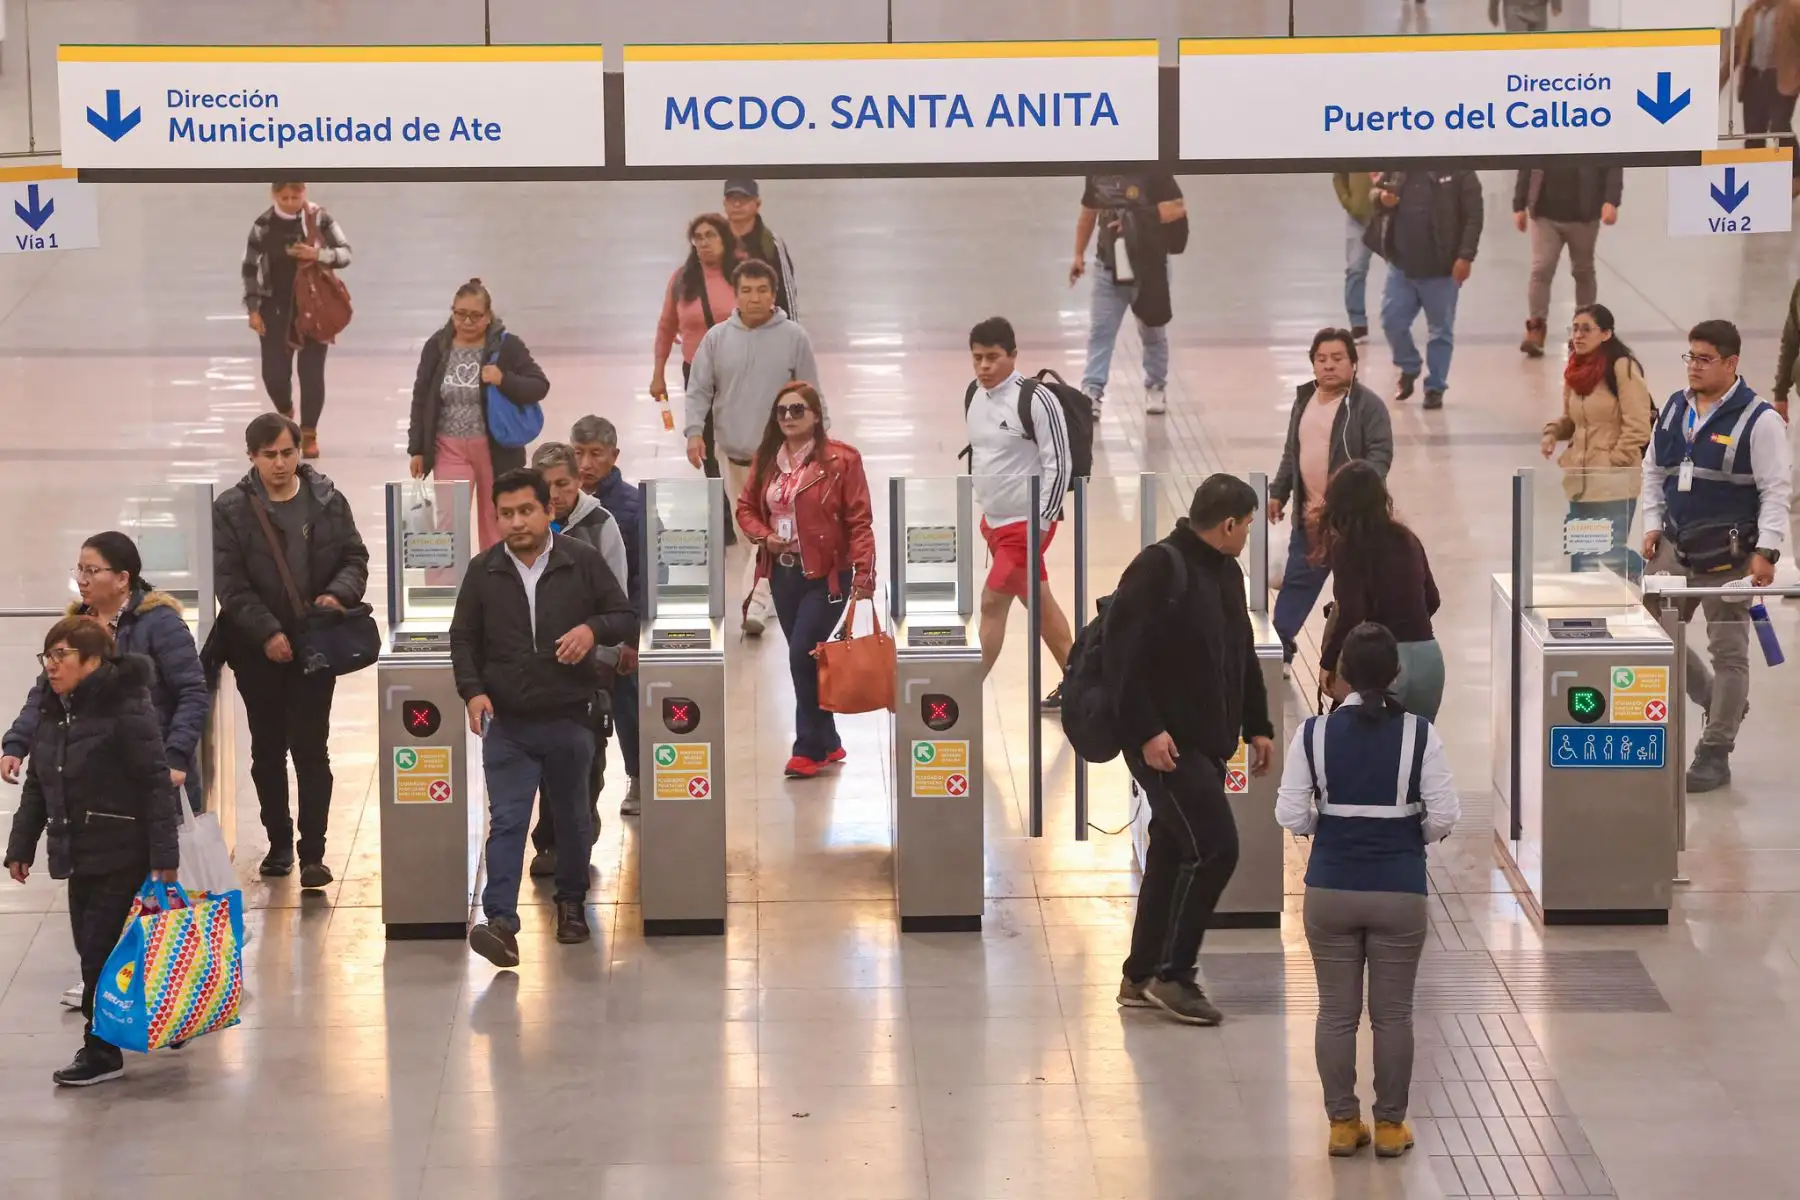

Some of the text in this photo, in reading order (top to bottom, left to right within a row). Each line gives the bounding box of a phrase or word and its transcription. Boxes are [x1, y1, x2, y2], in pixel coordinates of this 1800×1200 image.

[1507, 73, 1611, 92] Dirección
[167, 89, 279, 108] Dirección
[664, 92, 1120, 131] MCDO. SANTA ANITA
[1323, 100, 1612, 132] Puerto del Callao
[168, 116, 502, 149] Municipalidad de Ate
[1708, 216, 1751, 233] Vía 2
[16, 233, 59, 250] Vía 1
